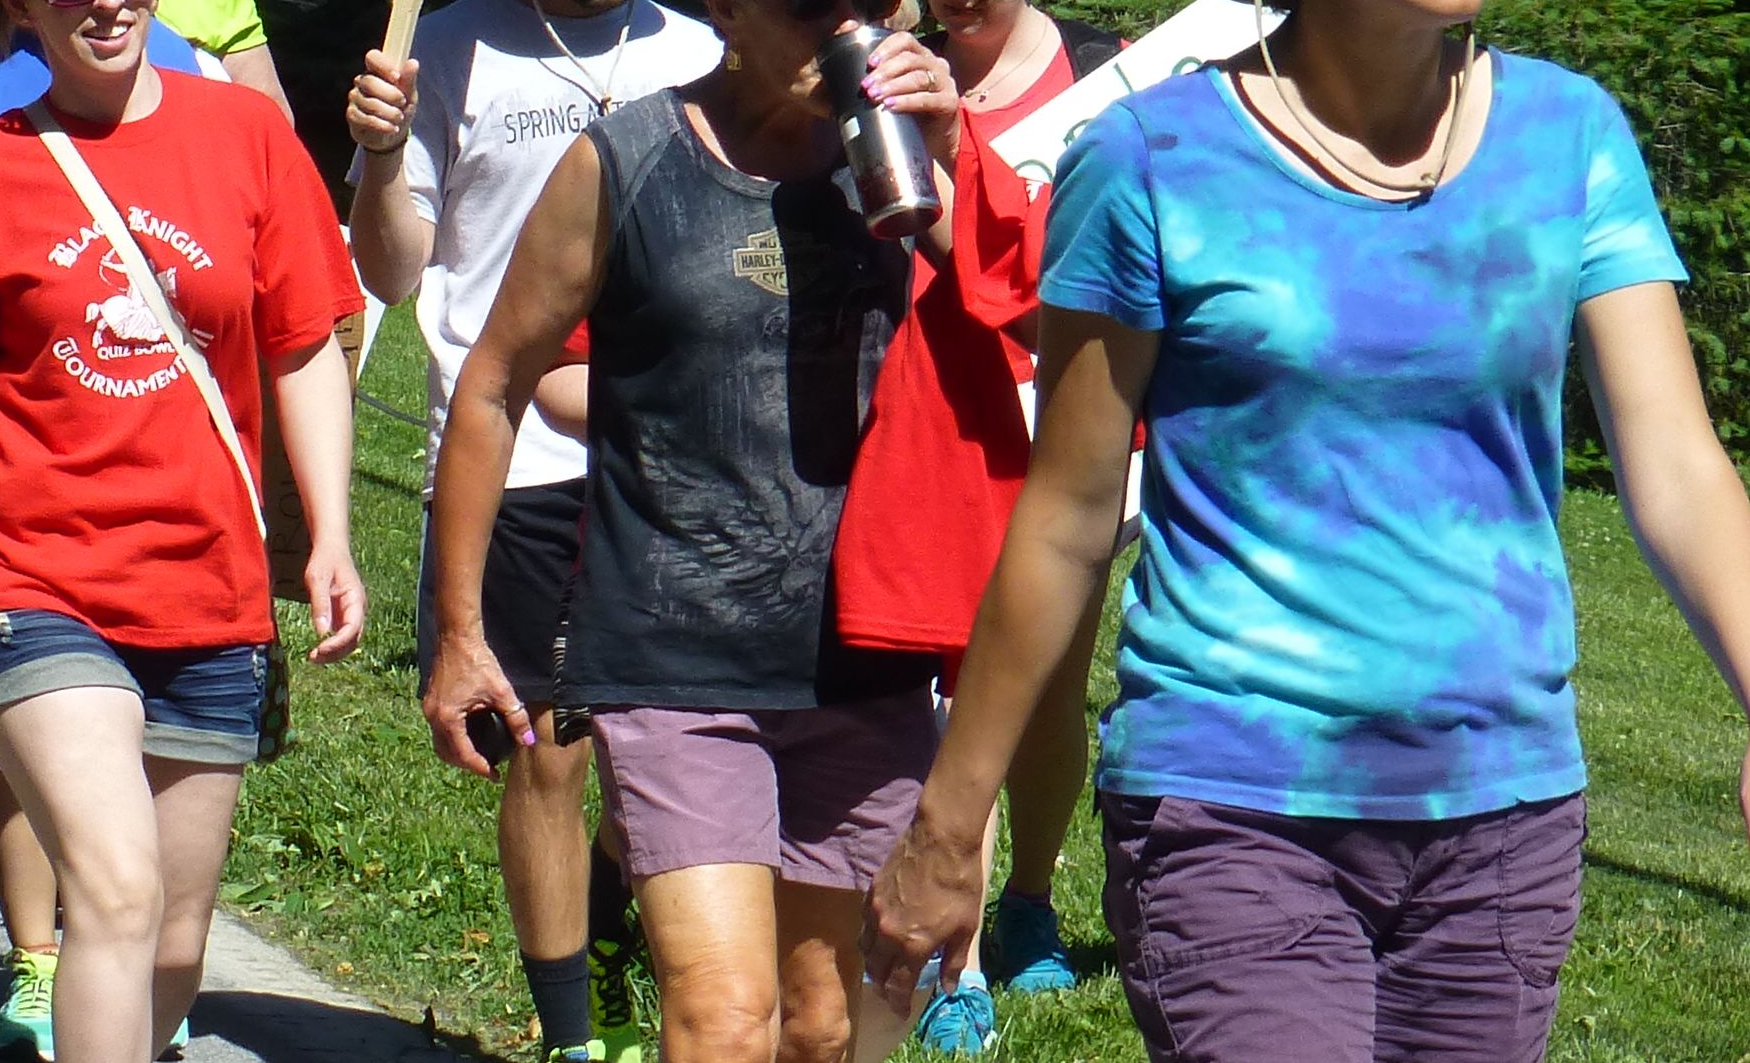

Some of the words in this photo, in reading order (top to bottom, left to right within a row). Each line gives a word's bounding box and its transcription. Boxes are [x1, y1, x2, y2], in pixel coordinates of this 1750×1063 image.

[504, 103, 581, 144] SPRING
[128, 205, 213, 272] KNIGHT
[52, 337, 188, 398] TOURNAMENT
